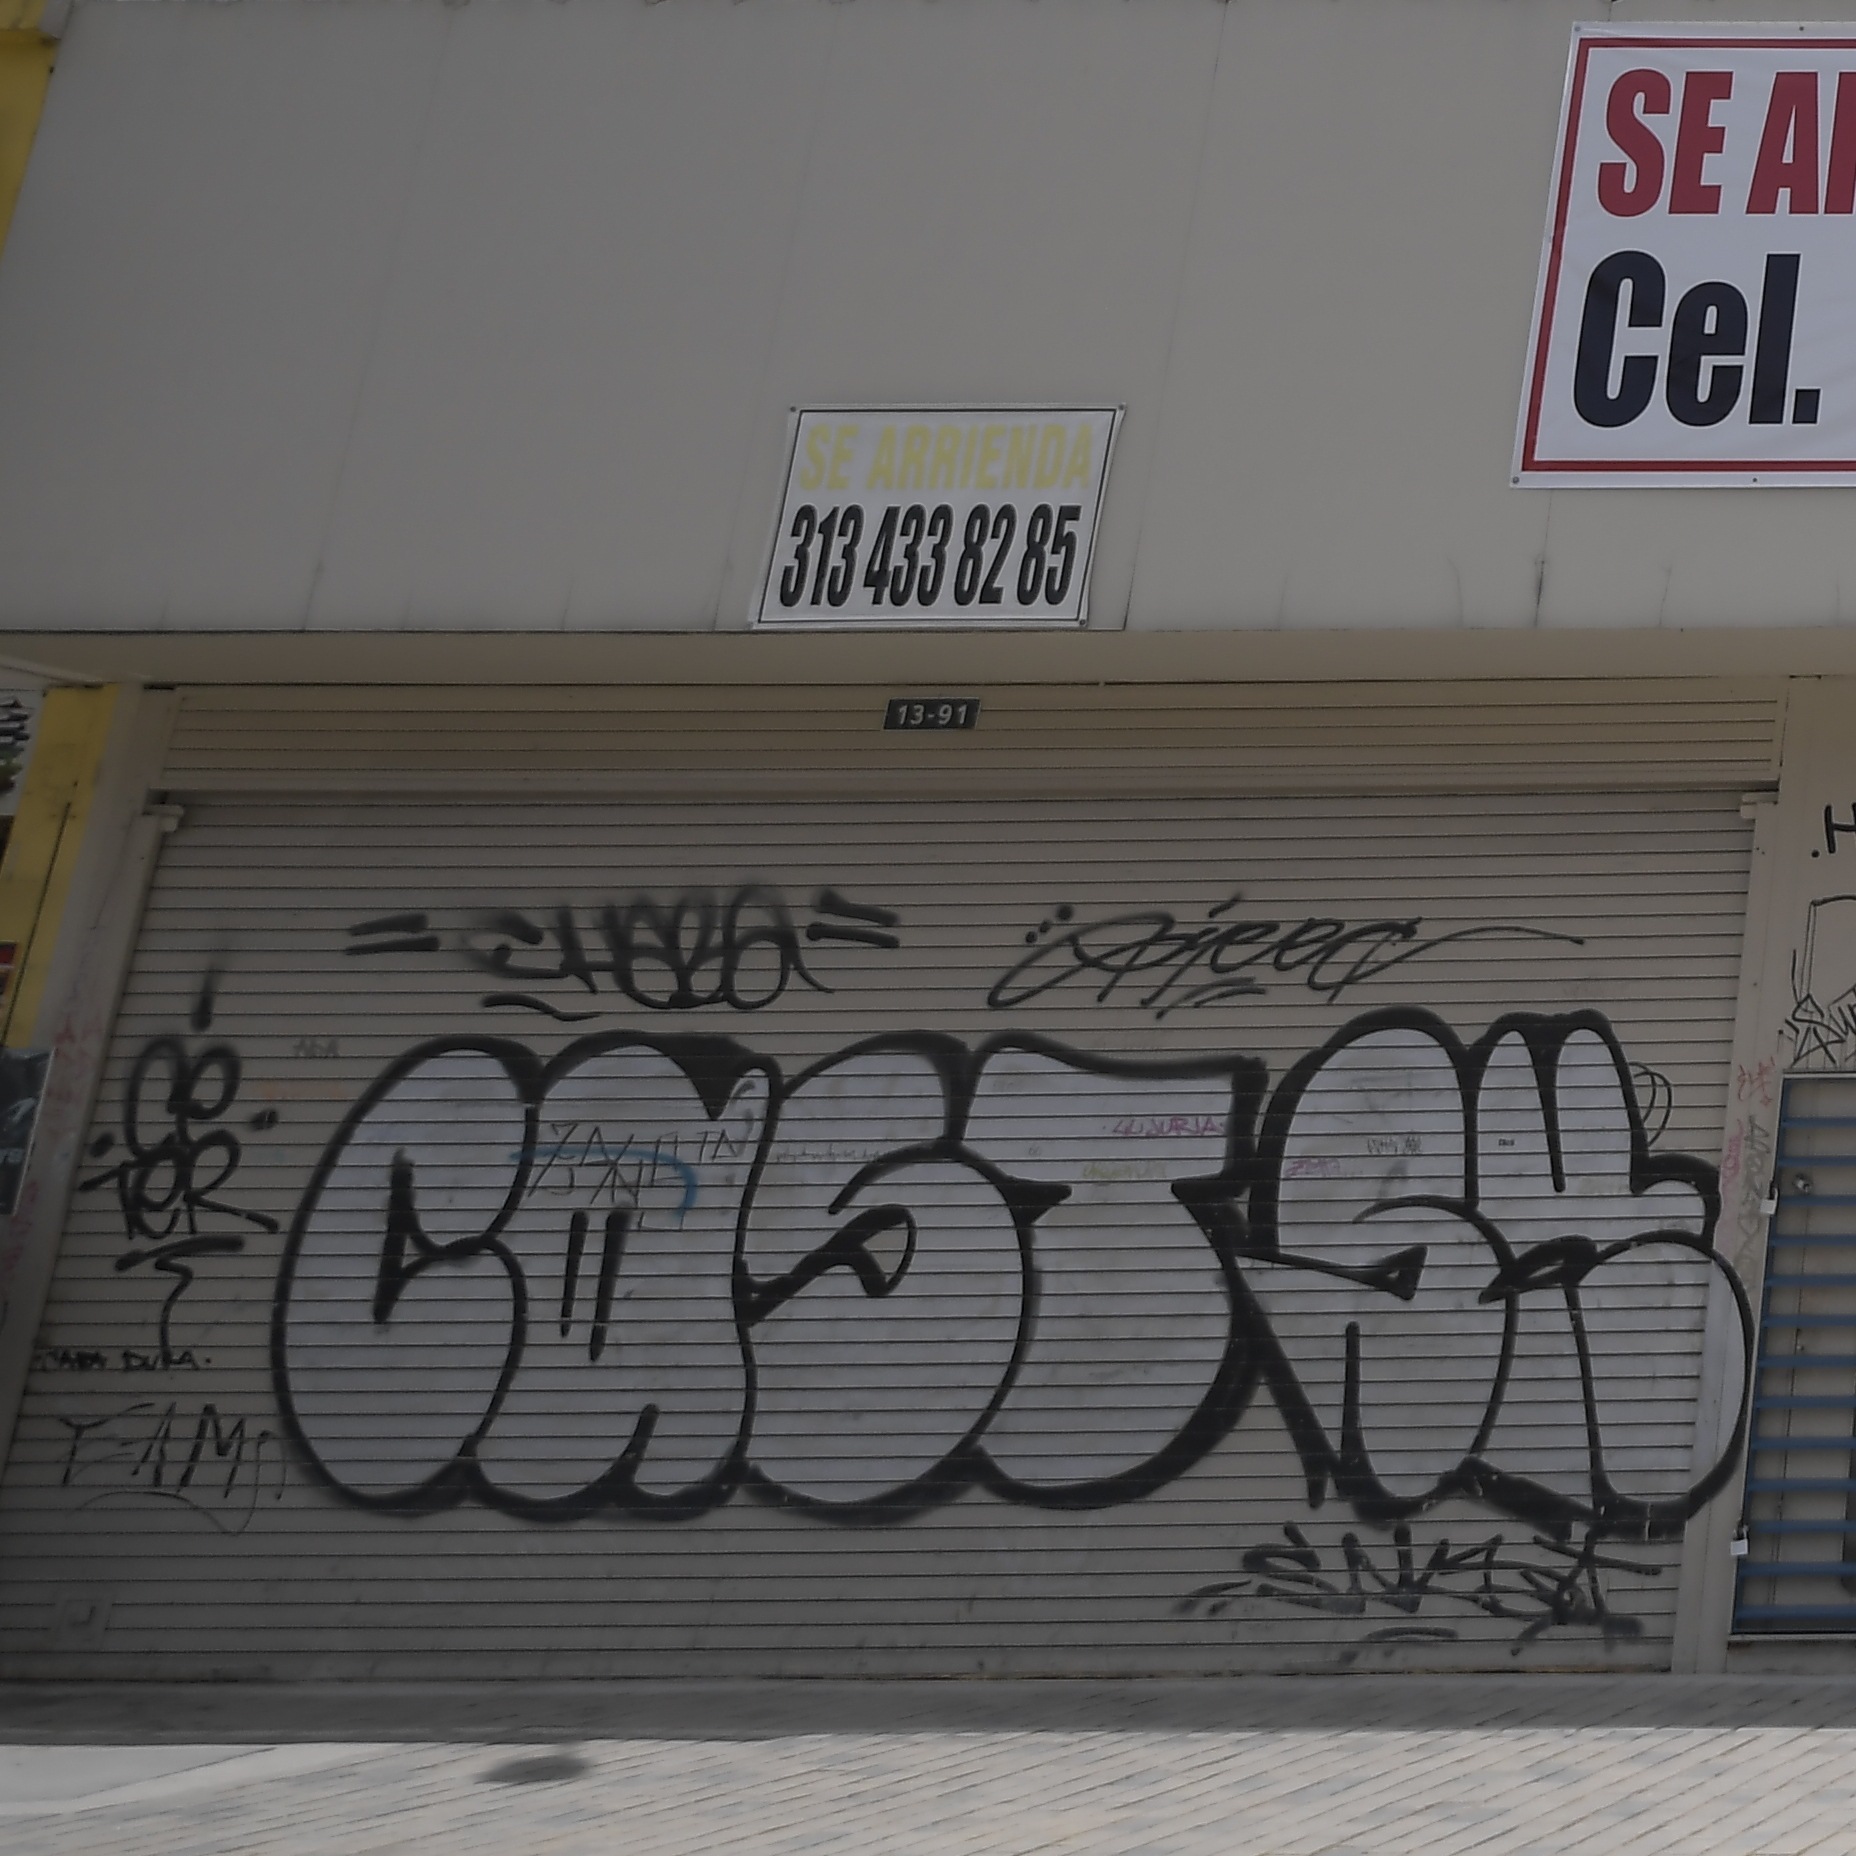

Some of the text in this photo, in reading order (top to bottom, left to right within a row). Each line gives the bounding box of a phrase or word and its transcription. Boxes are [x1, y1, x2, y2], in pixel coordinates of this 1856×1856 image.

[1598, 68, 1732, 216] SE
[1572, 251, 1820, 427] Cel.
[802, 424, 1093, 490] SE ARRIENDA
[780, 503, 1082, 608] 313 433 82 85
[898, 704, 967, 726] 13-91
